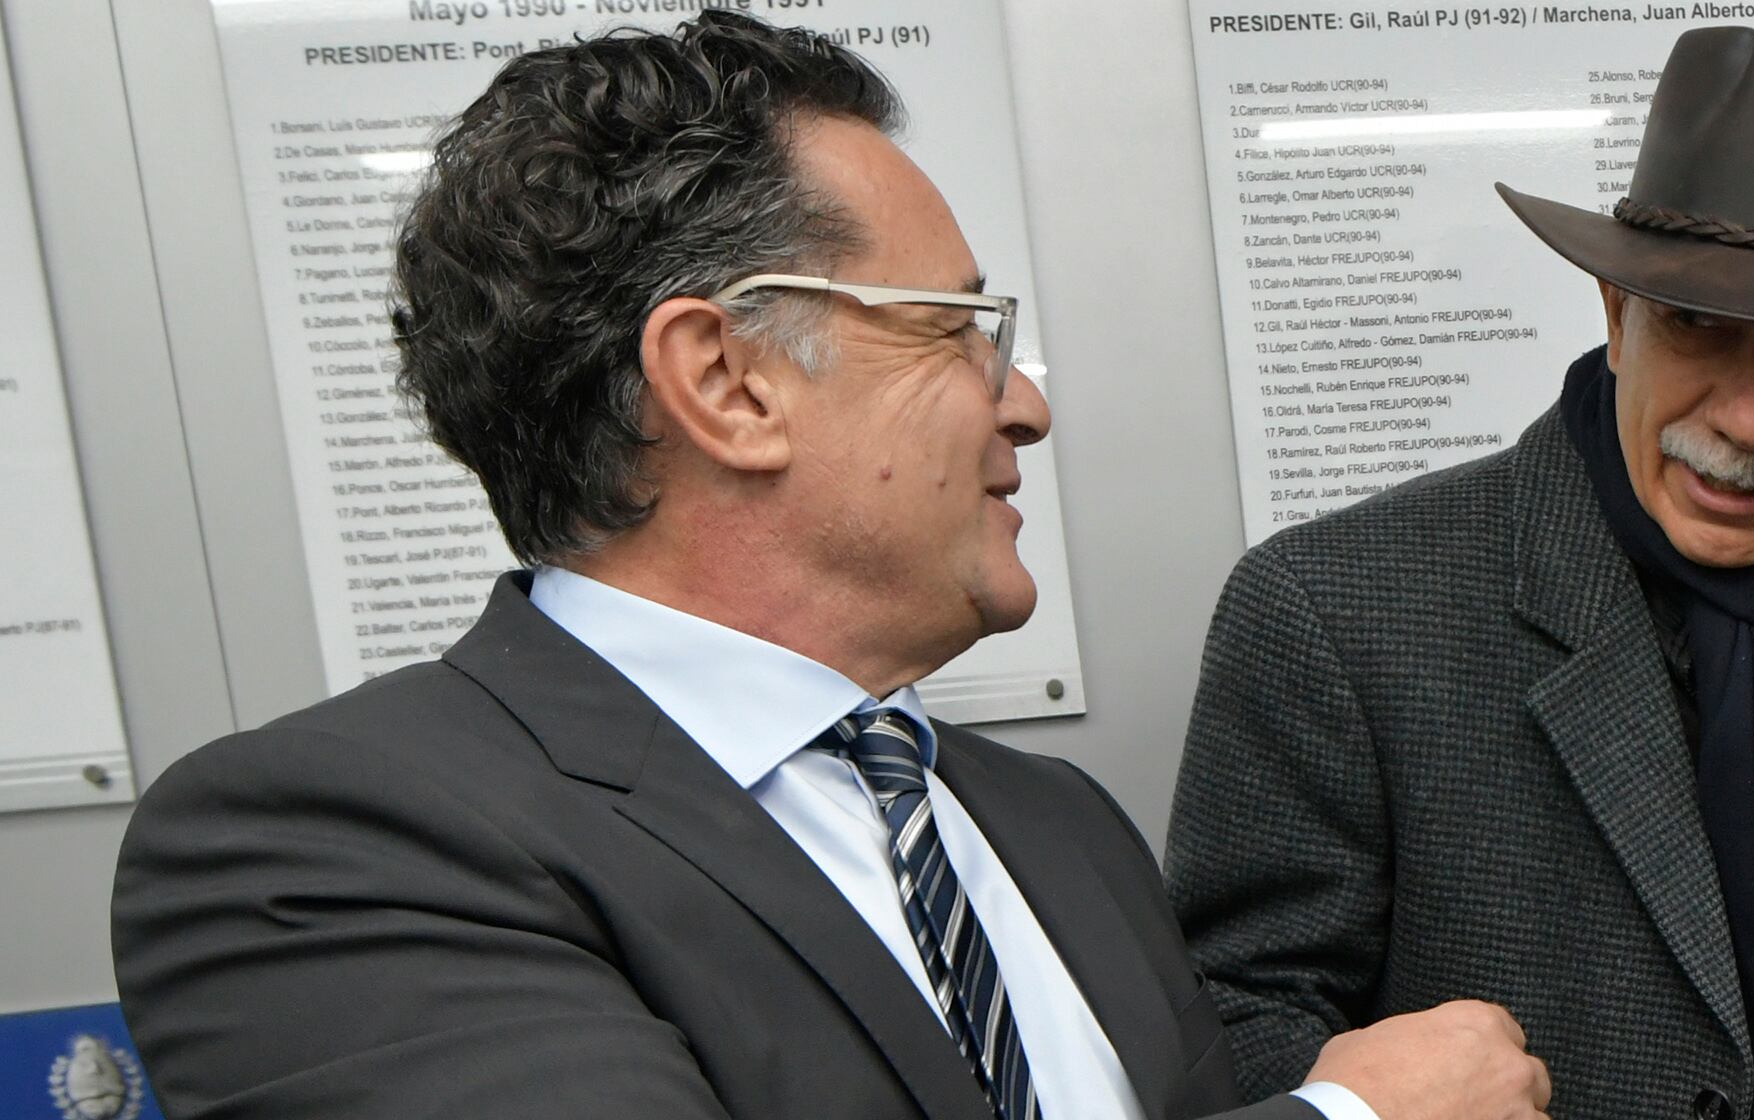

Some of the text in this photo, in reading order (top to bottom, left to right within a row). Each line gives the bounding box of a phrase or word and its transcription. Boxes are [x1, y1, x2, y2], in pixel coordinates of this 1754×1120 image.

[409, 0, 488, 26] Mayo
[1209, 13, 1343, 32] PRESIDENTE:
[1349, 11, 1381, 30] Gil,
[1387, 10, 1430, 27] Raúl
[1435, 9, 1458, 26] PJ
[1464, 7, 1527, 29] (91-92)
[1543, 6, 1637, 23] Marchena,
[1642, 4, 1686, 20] Juan
[857, 27, 884, 45] PJ
[892, 25, 930, 48] (91)
[304, 43, 466, 65] PRESIDENTE:
